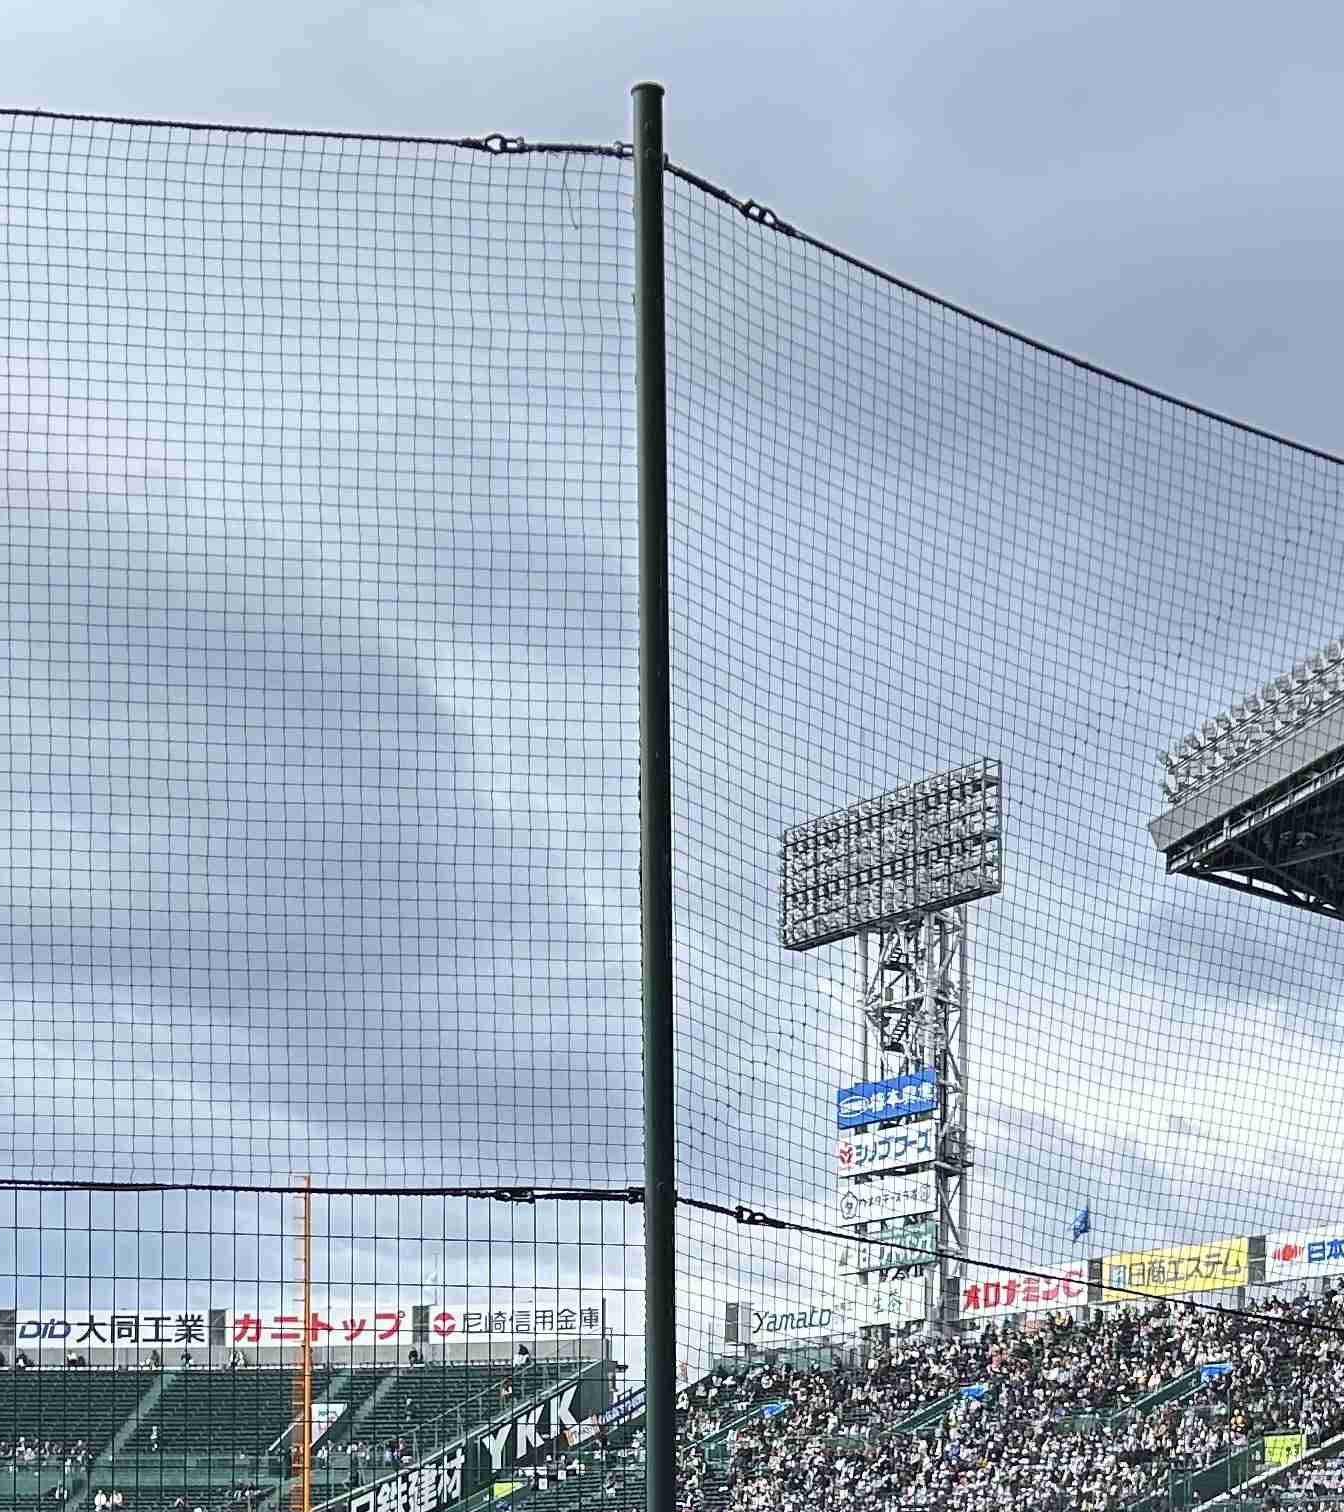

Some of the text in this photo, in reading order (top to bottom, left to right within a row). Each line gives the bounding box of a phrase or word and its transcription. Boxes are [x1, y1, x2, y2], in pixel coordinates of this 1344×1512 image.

[962, 1268, 1084, 1311] オロナミンC
[76, 1313, 205, 1343] 大同工業
[233, 1310, 406, 1342] カニトップ
[462, 1307, 599, 1333] 尼崎信用金庫
[752, 1308, 831, 1334] Yamato
[480, 1384, 578, 1470] YKK
